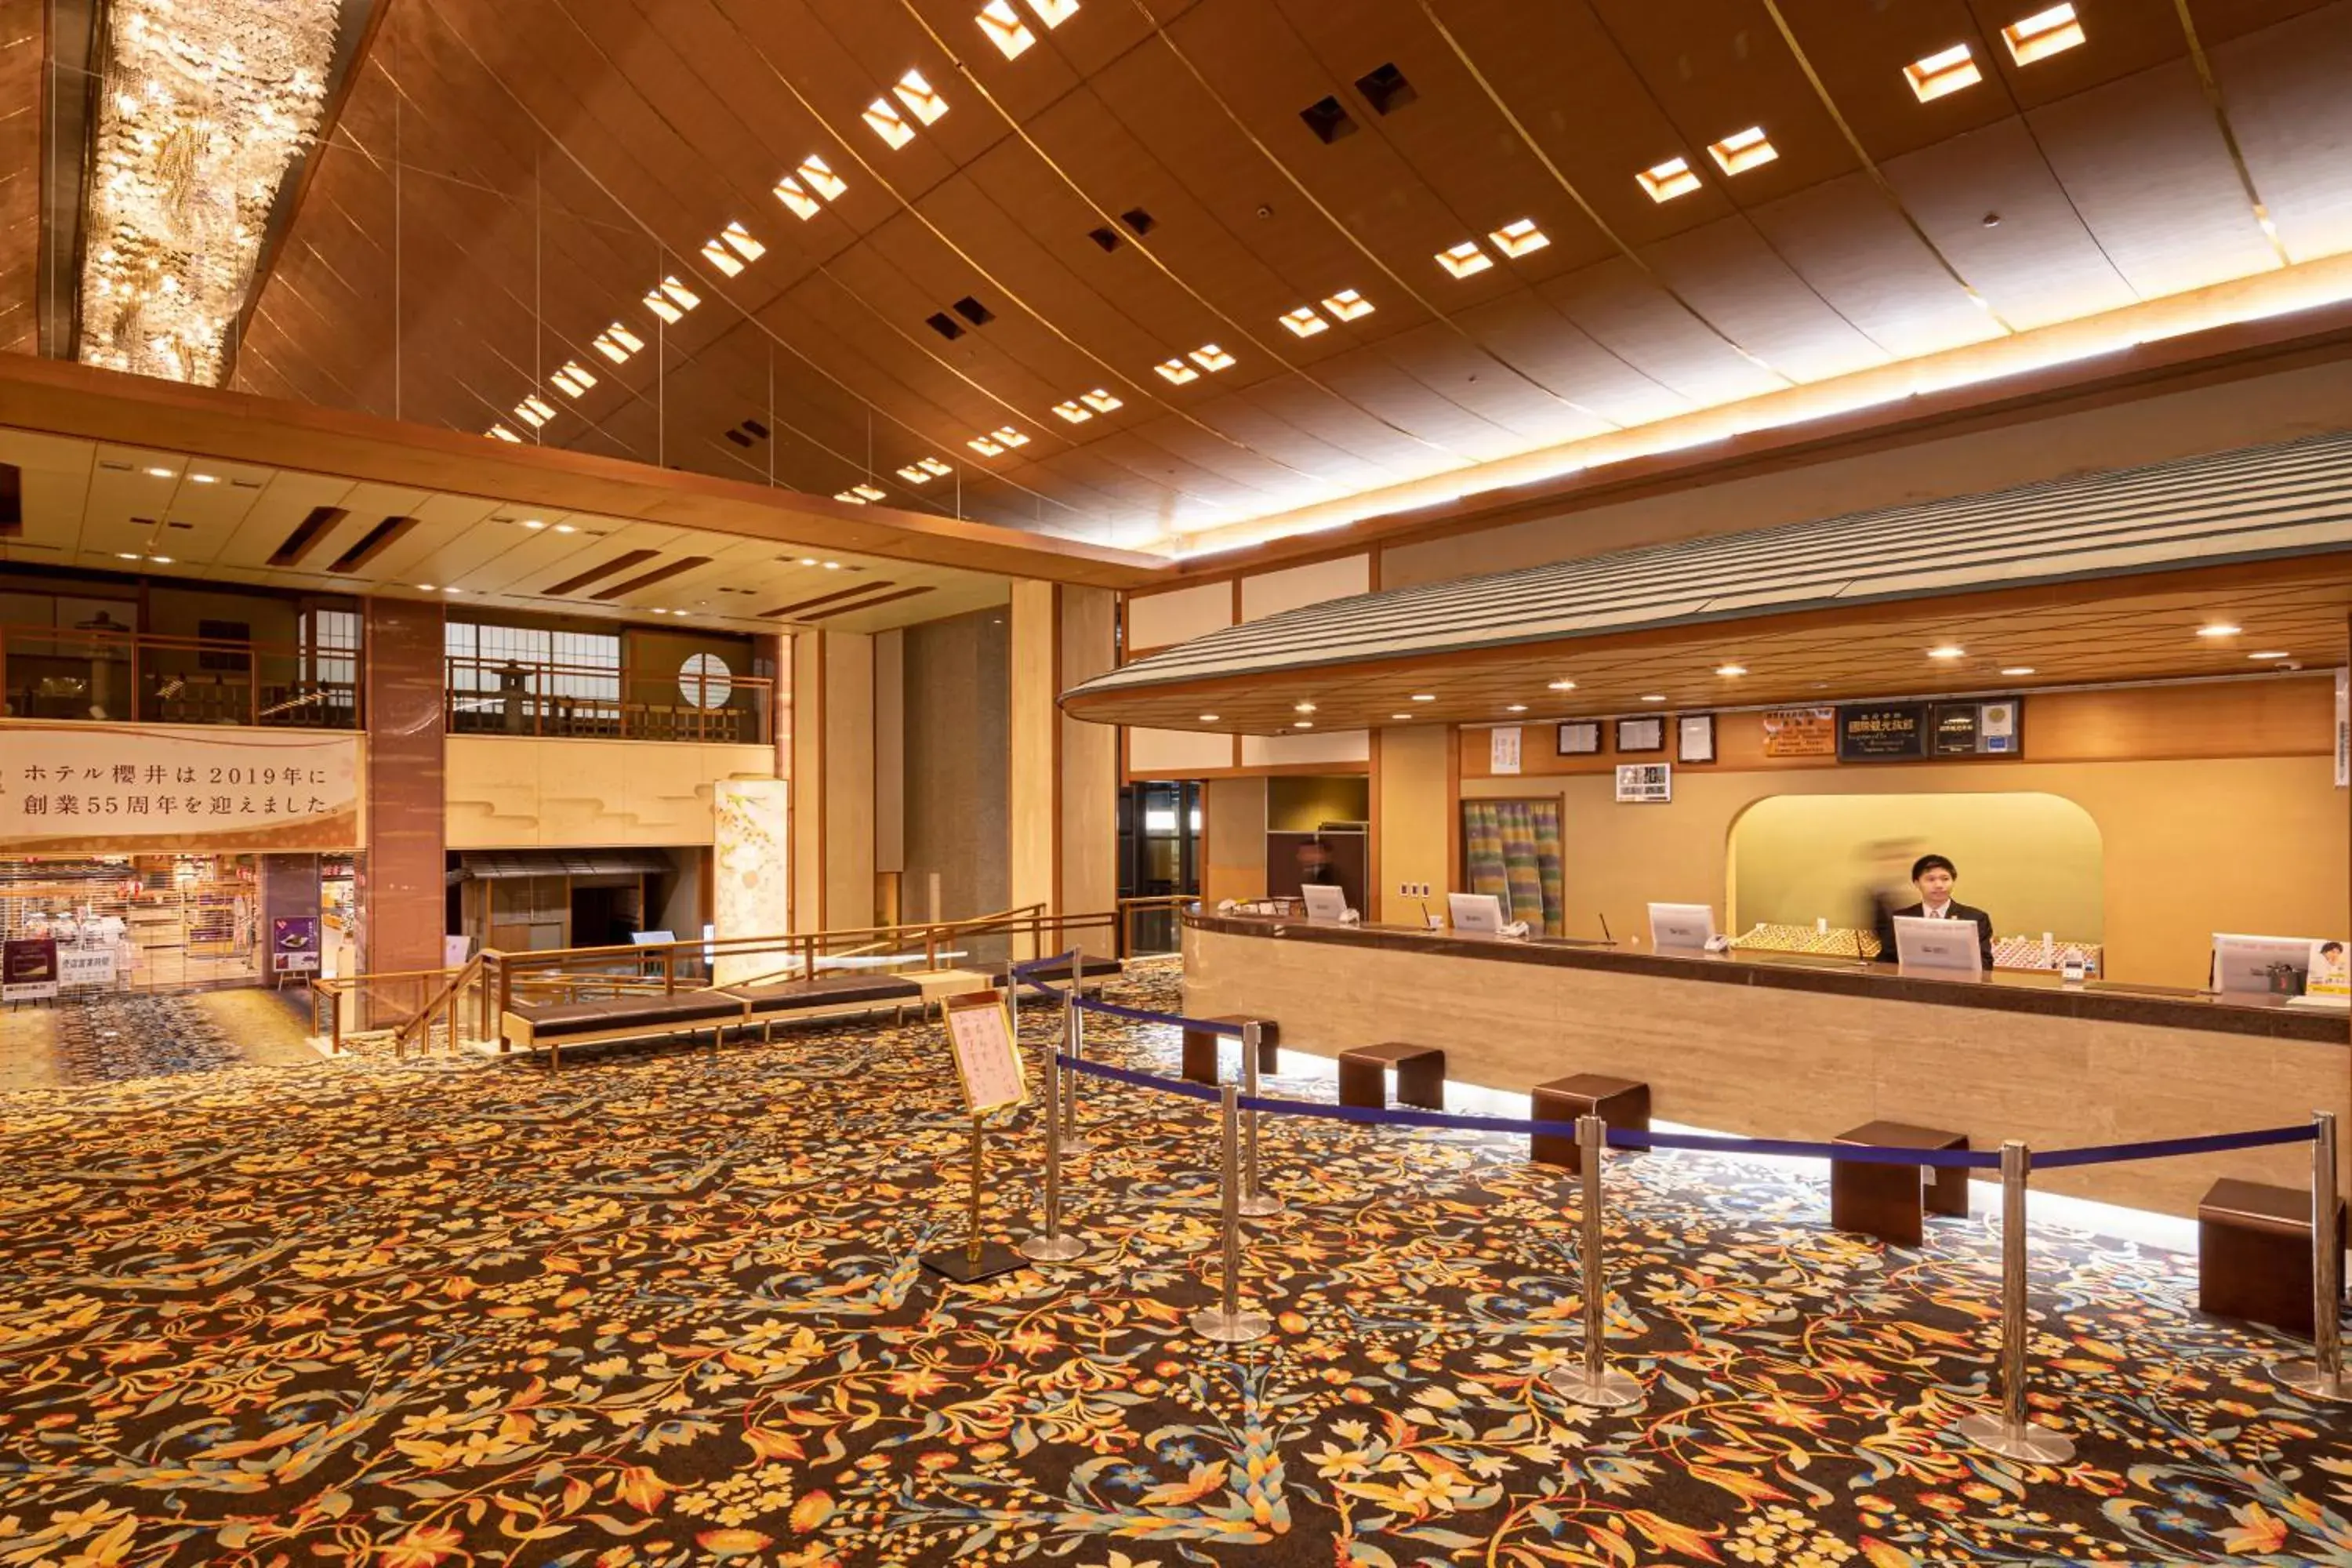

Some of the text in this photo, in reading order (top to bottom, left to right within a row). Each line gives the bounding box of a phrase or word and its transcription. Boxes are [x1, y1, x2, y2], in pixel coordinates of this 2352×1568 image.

[24, 764, 325, 785] ホテル櫻井は2019年に
